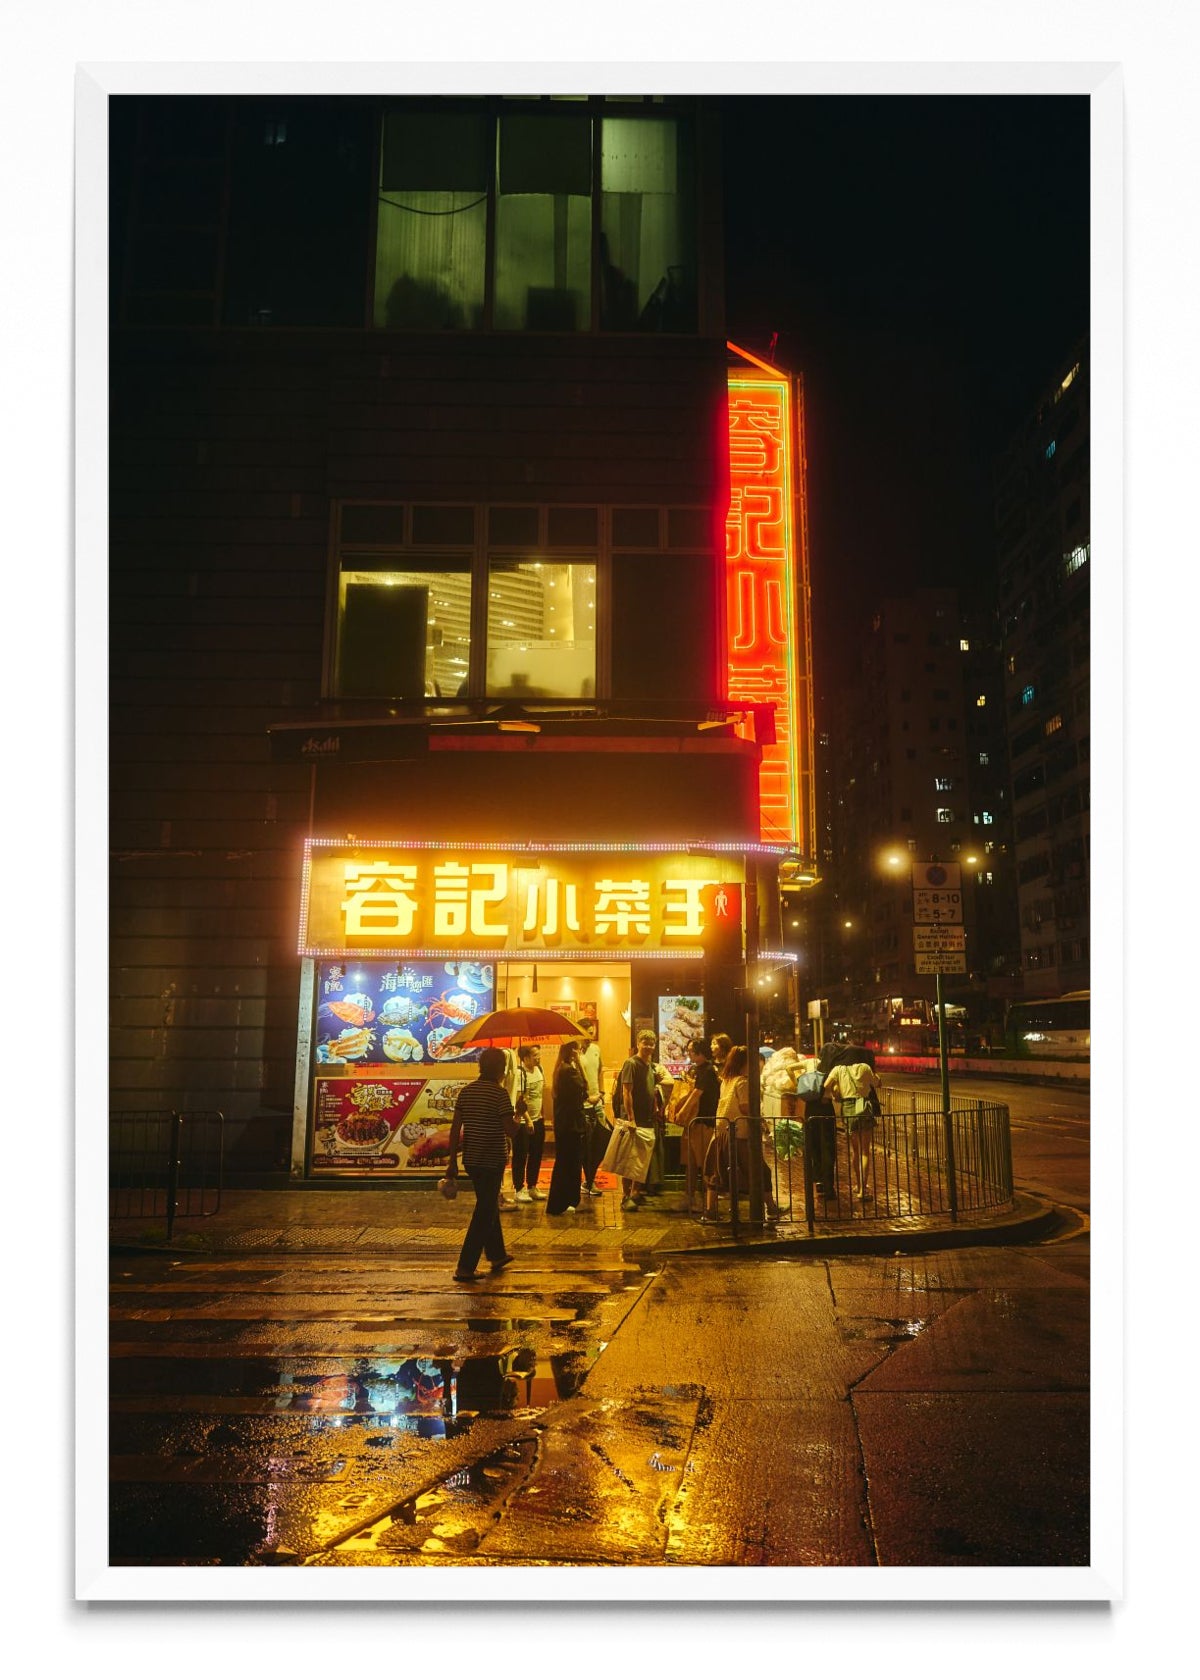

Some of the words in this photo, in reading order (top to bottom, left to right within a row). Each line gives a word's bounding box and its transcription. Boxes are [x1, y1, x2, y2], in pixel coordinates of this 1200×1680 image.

[341, 861, 718, 936] 容記小菜王
